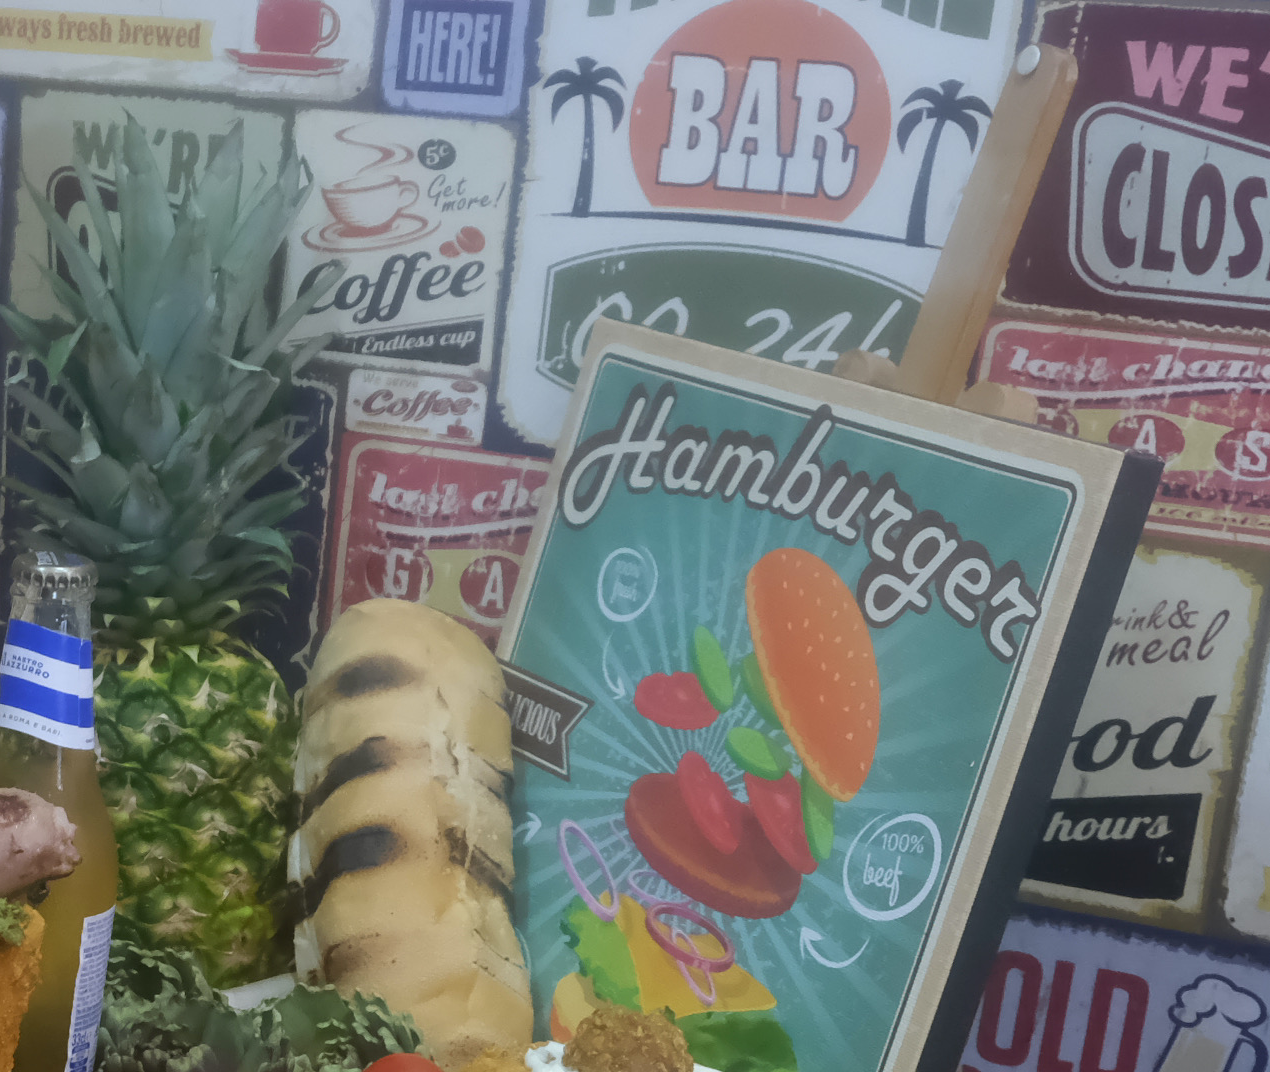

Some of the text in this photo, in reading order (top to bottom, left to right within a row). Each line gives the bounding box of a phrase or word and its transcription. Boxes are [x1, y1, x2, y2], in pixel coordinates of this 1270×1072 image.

[58, 14, 112, 44] fresh
[119, 19, 201, 48] brewed
[407, 9, 502, 87] HERE!
[658, 51, 859, 200] BAR
[427, 173, 468, 207] Get
[441, 181, 507, 214] more!
[1102, 140, 1270, 279] CLOS
[295, 251, 487, 324] Coffee
[361, 329, 477, 354] Endless cup
[1121, 354, 1270, 382] chan
[361, 388, 475, 423] Coffee
[1133, 418, 1157, 456] A
[560, 392, 1040, 662] Hamburger
[480, 560, 505, 610] A
[1106, 609, 1231, 668] meal
[12, 653, 44, 669] NASTRO
[1069, 694, 1217, 773] od
[882, 832, 926, 854] 100%
[1042, 810, 1174, 843] hours
[862, 852, 904, 907] beef
